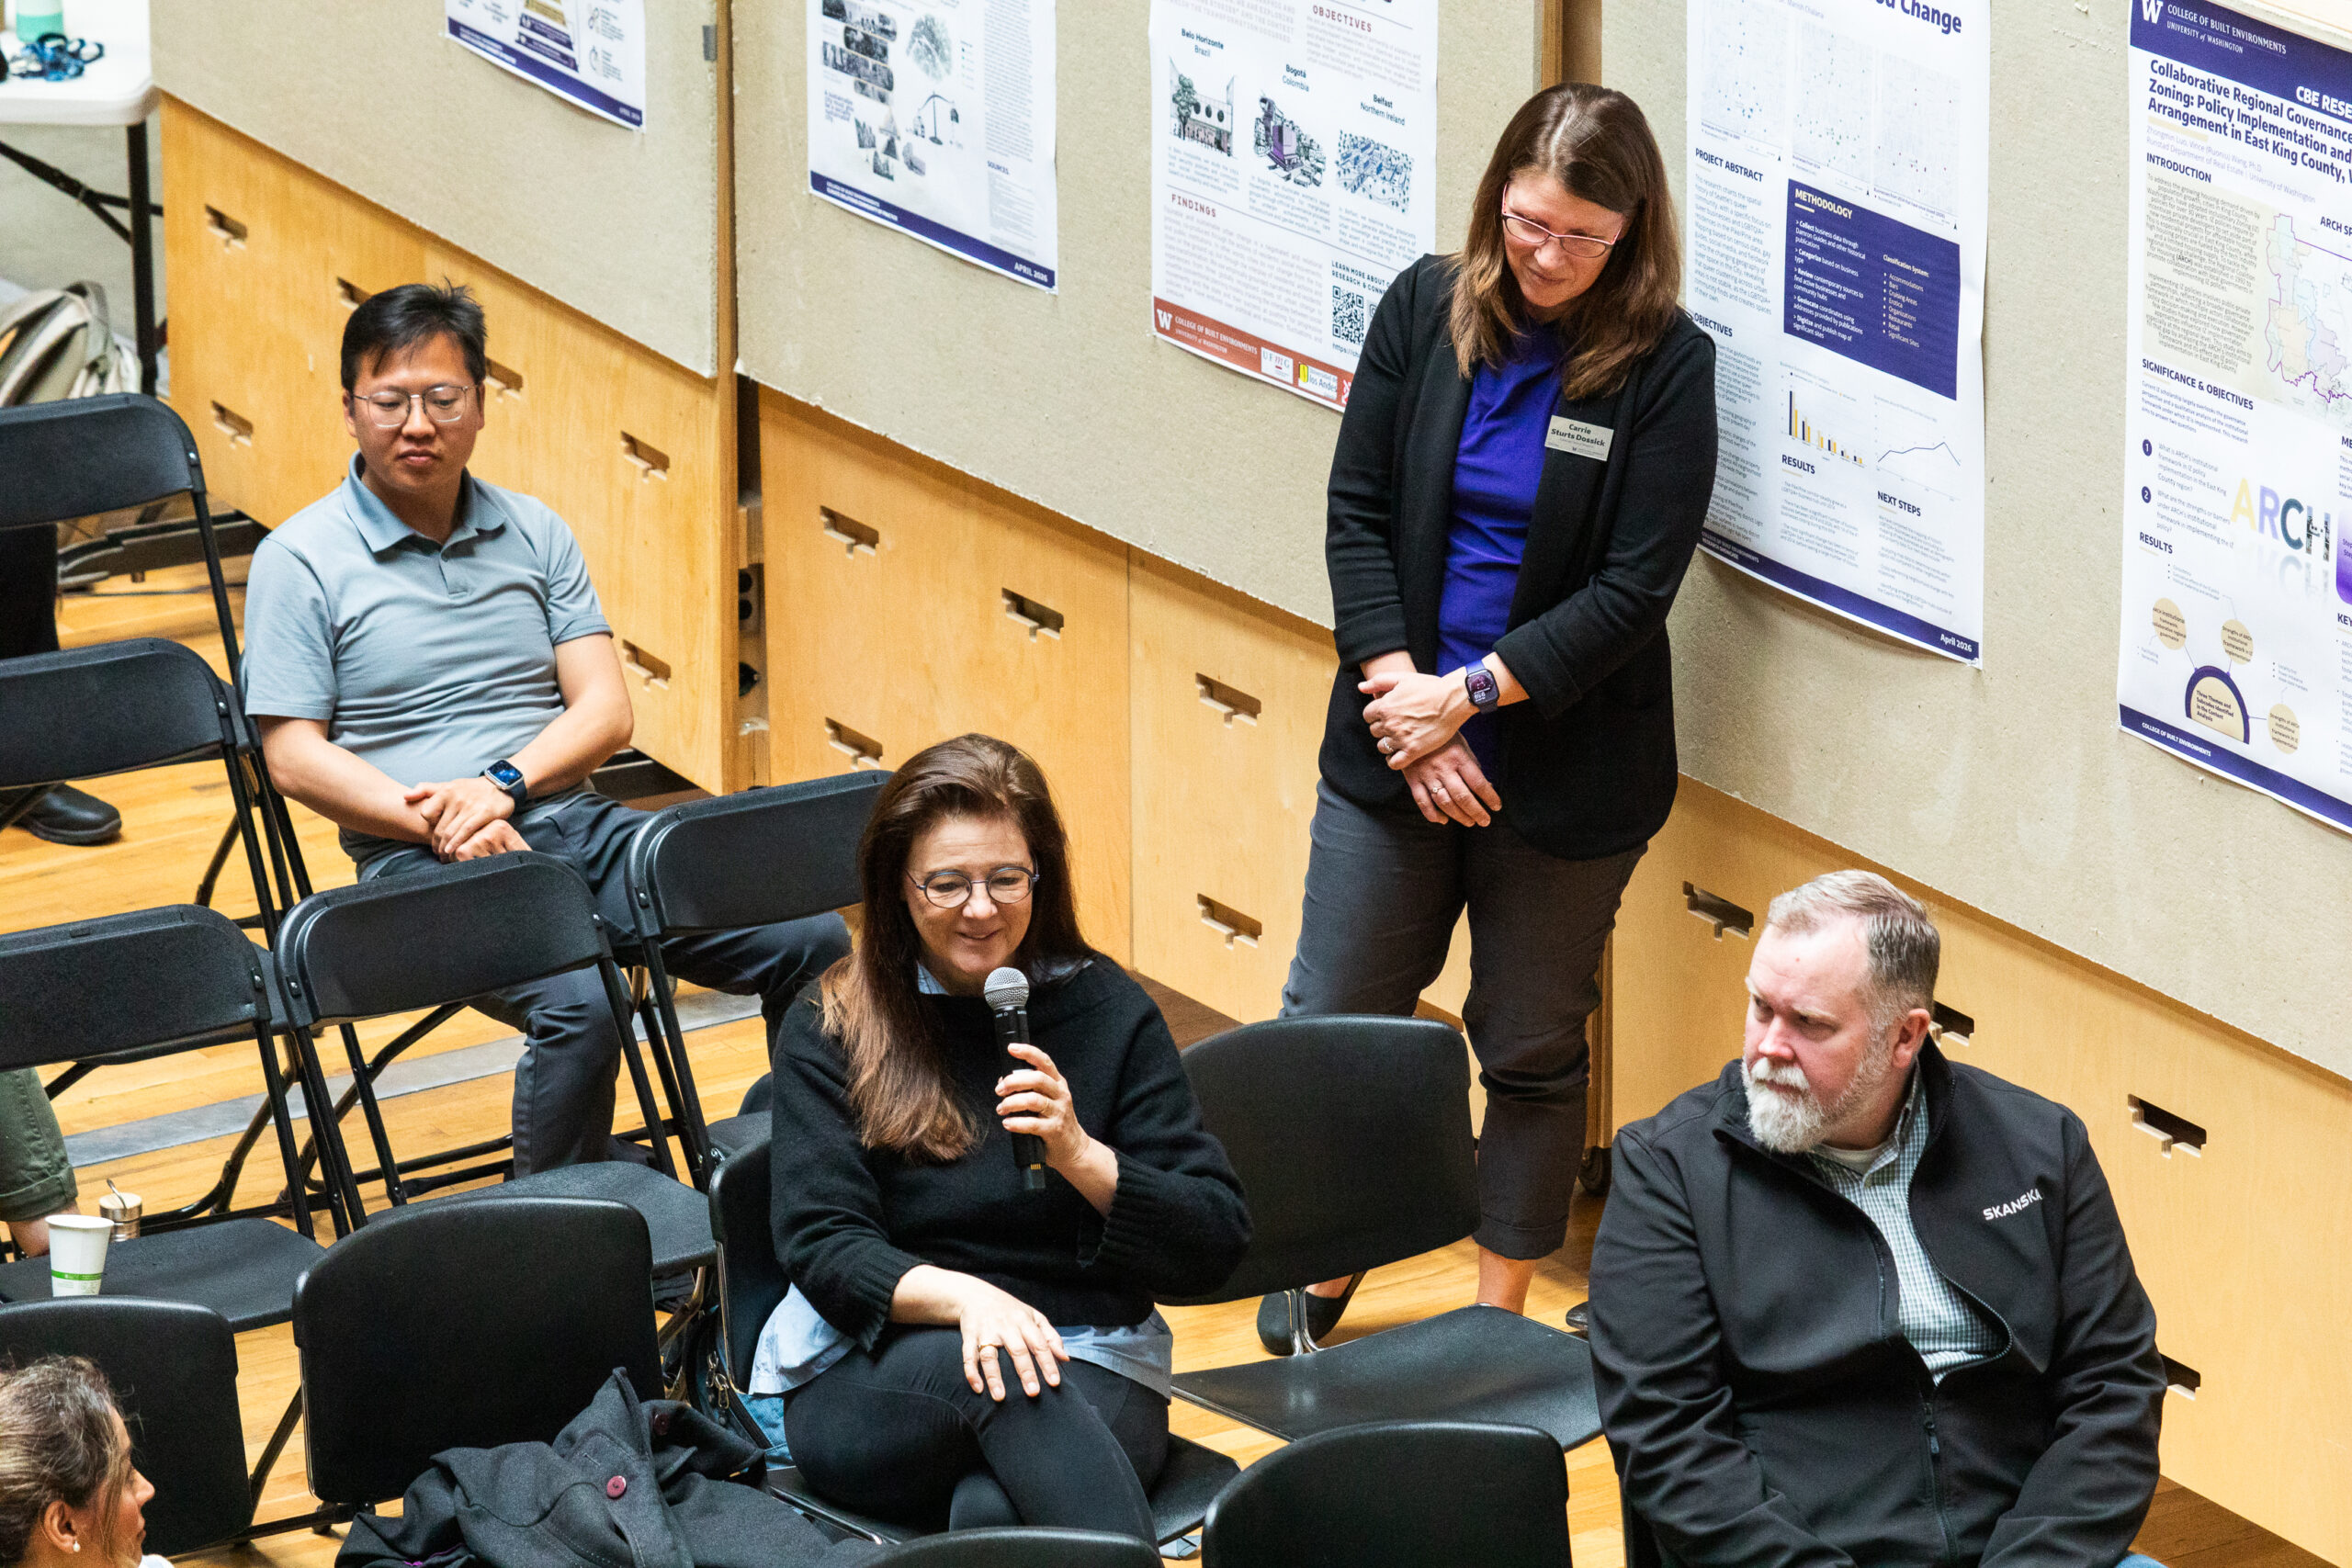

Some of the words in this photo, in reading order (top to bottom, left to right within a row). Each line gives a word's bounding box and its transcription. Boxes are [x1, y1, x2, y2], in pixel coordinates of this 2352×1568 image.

[1313, 5, 1372, 32] OBJECTIVES
[1901, 0, 1962, 34] Change
[1182, 28, 1194, 39] Belo
[1196, 33, 1224, 50] Horizonte
[2167, 5, 2198, 23] COLLEGE
[2199, 15, 2209, 27] OF
[2211, 19, 2230, 35] BUILT
[2232, 28, 2287, 54] ENVIRONMENTS
[2167, 21, 2199, 39] UNIVERSITY
[2200, 33, 2206, 42] of
[2208, 34, 2243, 53] WASHINGTON
[1194, 45, 1211, 57] Brazil
[1286, 63, 1306, 79] Bogotá
[1283, 75, 1309, 92] Colombia
[1374, 94, 1393, 108] Belfast
[2151, 60, 2230, 98] Collaborative
[2233, 87, 2283, 118] Regional
[2287, 107, 2352, 143] Governance
[2296, 86, 2320, 107] CBE
[1361, 102, 1385, 118] Northern
[1386, 112, 1405, 126] Ireland
[2149, 79, 2194, 107] Zoning:
[2198, 97, 2233, 123] Policy
[2237, 108, 2327, 153] Implementation
[2330, 147, 2352, 164] and
[2148, 97, 2228, 135] Arrangement
[2232, 123, 2241, 141] in
[2245, 132, 2269, 152] East
[2272, 142, 2298, 166] King
[2301, 152, 2345, 184] County,
[988, 161, 1009, 175] SOURCES
[1696, 148, 1724, 167] PROJECT
[1725, 161, 1763, 182] ABSTRACT
[2147, 152, 2211, 183] INTRODUCTION
[1172, 194, 1216, 218] FINDINGS
[1794, 188, 1852, 220] METHODOLOGY
[1796, 228, 1812, 238] Damron
[1800, 220, 1815, 231] Collect
[1815, 225, 1832, 239] business
[1833, 232, 1842, 241] data
[2321, 216, 2342, 232] ARCH
[1795, 235, 1820, 250] publications
[1014, 262, 1033, 276] APRIL
[1331, 260, 1349, 272] LEARN
[1351, 269, 1365, 279] MORE
[1367, 275, 1385, 285] ABOUT
[1799, 248, 1821, 263] Categorize
[1822, 256, 1834, 267] based
[1841, 265, 1859, 276] business
[1883, 254, 1911, 271] Classification
[1332, 270, 1360, 286] RESEARCH
[1798, 268, 1813, 279] Review
[1889, 274, 1923, 291] Accommodations
[1794, 283, 1816, 299] community
[1889, 282, 1898, 290] Bars
[1889, 289, 1905, 302] Cruising
[1905, 297, 1917, 306] Areas
[1888, 306, 1917, 322] Organizations
[1175, 316, 1196, 330] COLLEGE
[1197, 324, 1204, 333] OF
[1205, 328, 1218, 338] BUILT
[1220, 333, 1257, 355] ENVIRONMENTS
[1694, 313, 1733, 337] OBJECTIVES
[1318, 378, 1337, 392] Andes
[2143, 358, 2196, 389] SIGNIFICANCE
[2199, 380, 2204, 390] &
[2207, 384, 2254, 410] OBJECTIVES
[1551, 428, 1575, 439] Sturts
[1576, 434, 1605, 446] Dossick
[1569, 423, 1591, 434] Carrie
[1781, 454, 1815, 474] RESULTS
[1878, 491, 1896, 506] NEXT
[1898, 496, 1921, 516] STEPS
[2144, 491, 2149, 499] 2
[2231, 478, 2331, 562] ARCH
[2140, 532, 2173, 554] RESULTS
[1940, 634, 1955, 646] April
[1957, 639, 1973, 652] 2026
[2197, 690, 2207, 699] Three
[2142, 722, 2160, 735] COLLEGE
[2179, 737, 2211, 756] ENVIRONMENTS
[1983, 1189, 2042, 1221] SKANSKA
